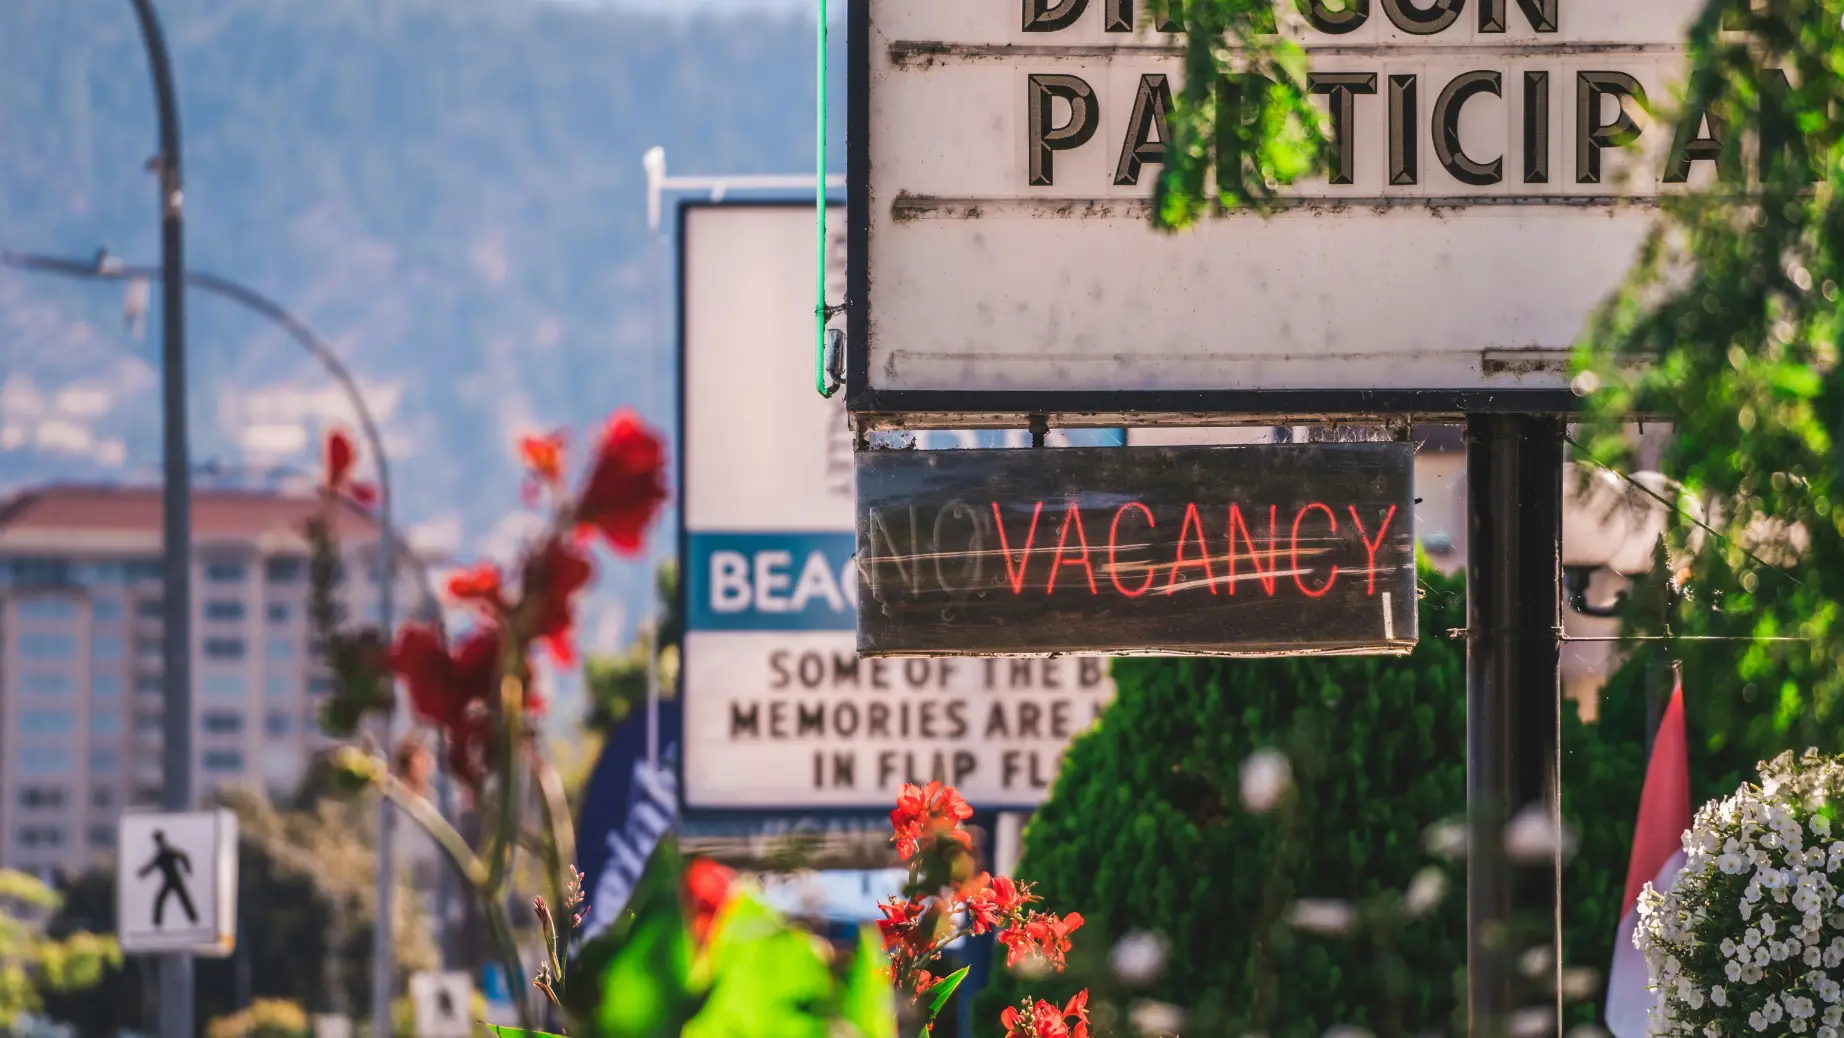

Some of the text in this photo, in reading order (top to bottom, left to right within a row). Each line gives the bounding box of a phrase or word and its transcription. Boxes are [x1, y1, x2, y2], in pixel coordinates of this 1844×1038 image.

[868, 499, 1398, 599] NO VACANCY
[768, 650, 889, 690] SOME
[903, 658, 955, 690] OF
[730, 700, 969, 739] MEMORIES
[984, 700, 1070, 738] ARE
[812, 752, 855, 788] IN
[1002, 750, 1062, 788] FL
